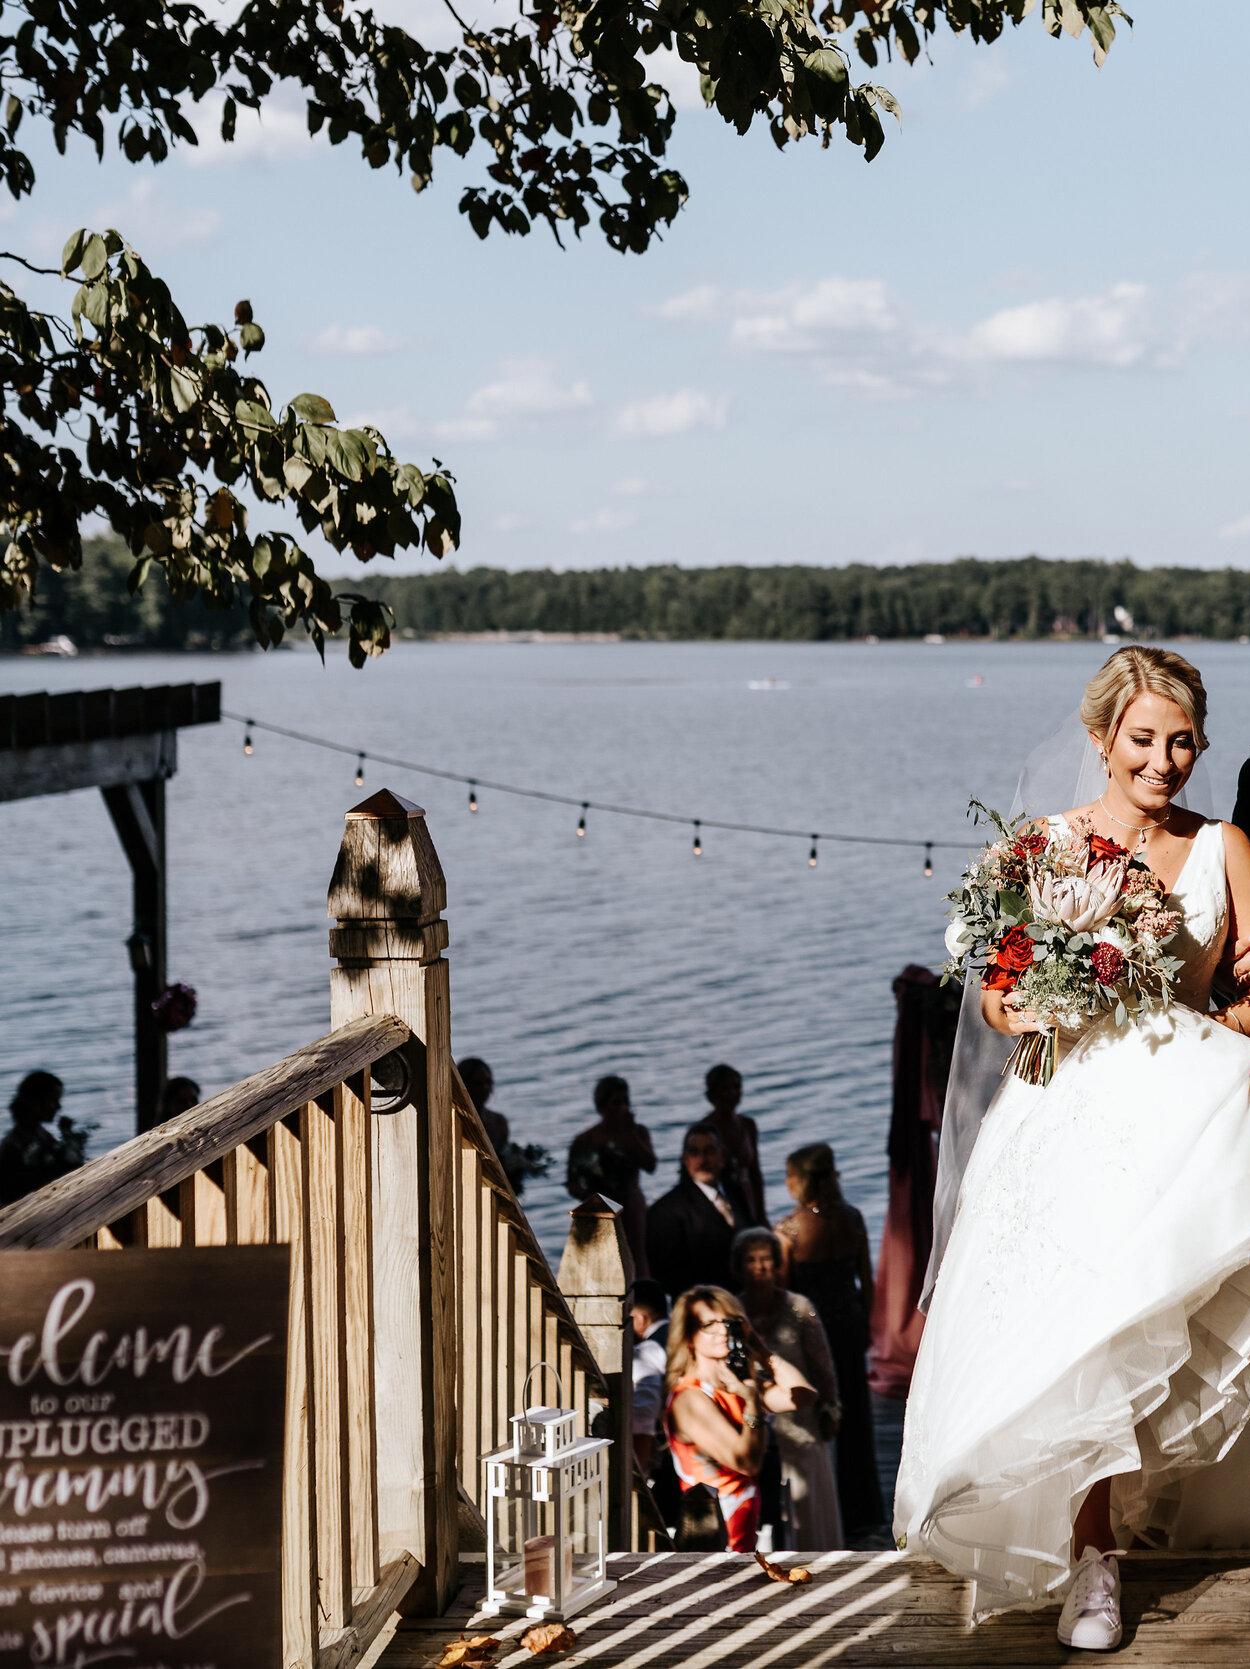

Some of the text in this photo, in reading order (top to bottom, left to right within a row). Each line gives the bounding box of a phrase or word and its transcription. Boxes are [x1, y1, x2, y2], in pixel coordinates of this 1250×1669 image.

[0, 1278, 273, 1387] elcome
[30, 1393, 115, 1415] to our
[0, 1413, 210, 1458] PLUGGED
[0, 1458, 266, 1530] remony
[57, 1518, 112, 1541] turn
[115, 1513, 151, 1538] off
[118, 1574, 164, 1600] and
[30, 1557, 253, 1664] special
